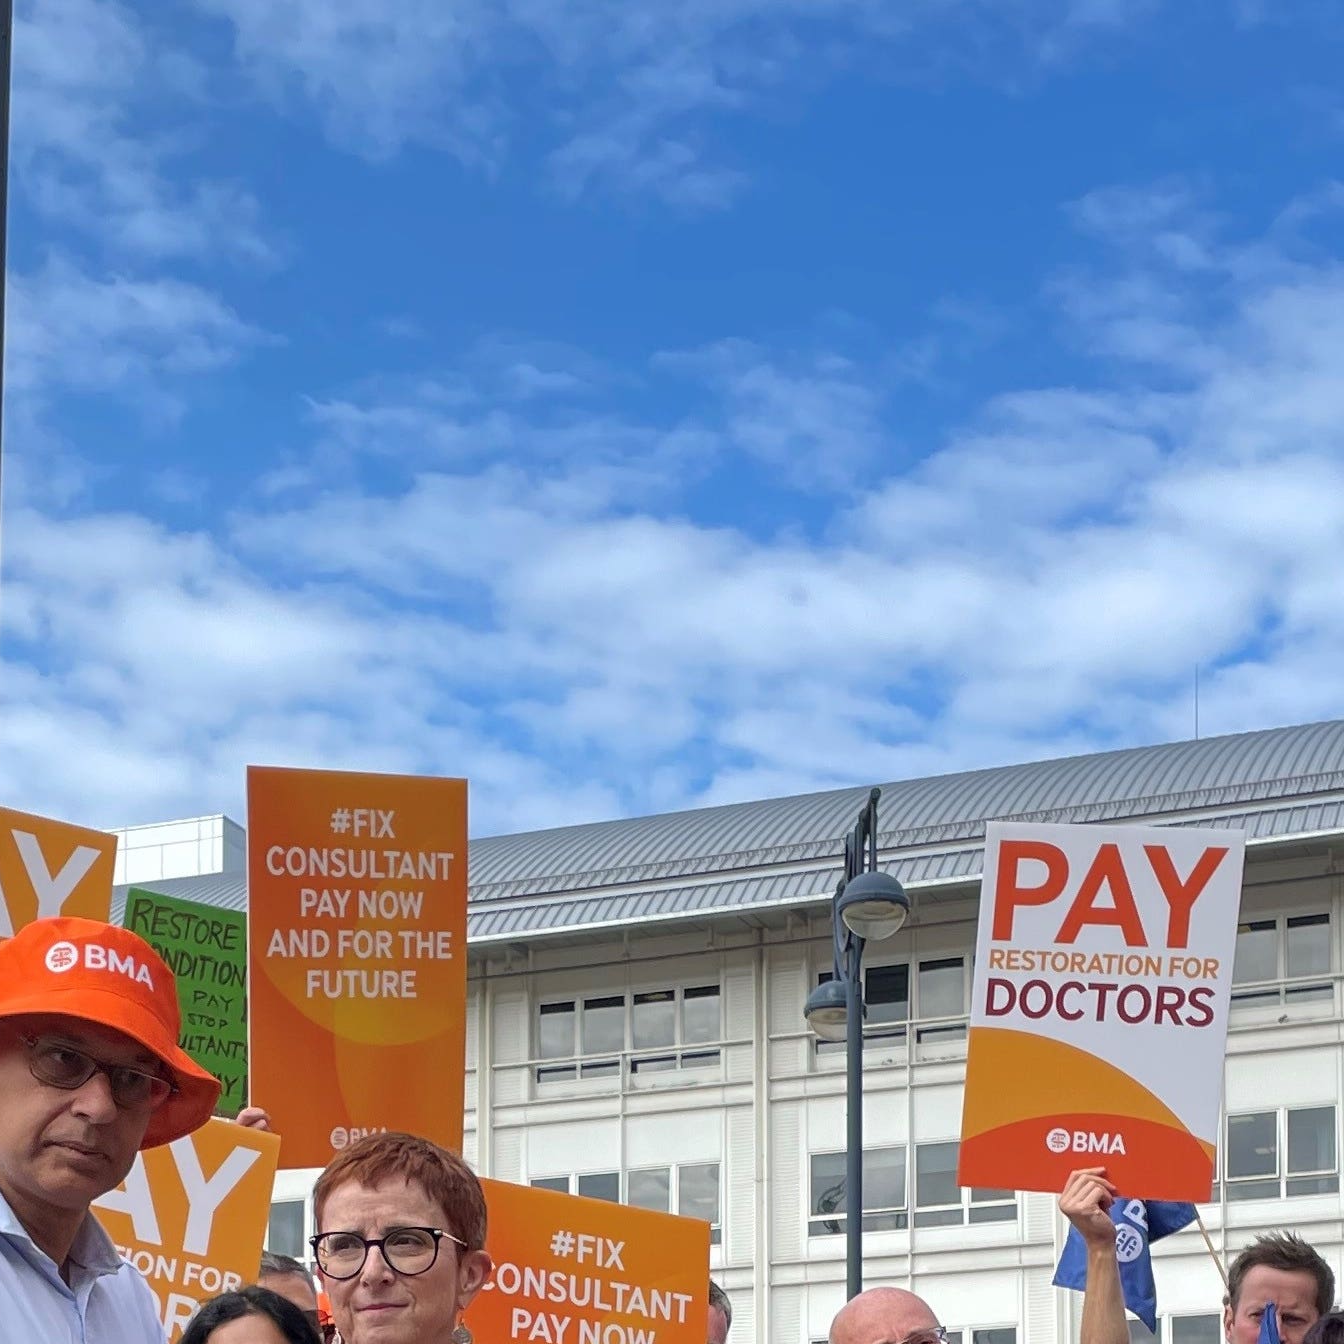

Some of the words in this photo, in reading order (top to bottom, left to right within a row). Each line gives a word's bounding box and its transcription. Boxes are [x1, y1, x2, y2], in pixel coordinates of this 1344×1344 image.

[330, 807, 396, 839] #FIX
[266, 845, 454, 881] CONSULTANT
[300, 888, 351, 919] PAY
[358, 890, 424, 920] NOW
[992, 839, 1230, 949] PAY
[130, 898, 241, 951] RESTORE
[267, 928, 330, 959] AND
[337, 930, 393, 959] FOR
[399, 931, 453, 960] THE
[84, 943, 155, 993] BMA
[989, 949, 1160, 978] RESTORATION
[1168, 957, 1220, 979] FOR
[306, 969, 417, 998] FUTURE
[193, 990, 233, 1013] PAY
[985, 977, 1216, 1028] DOCTORS
[187, 1013, 229, 1030] STOP
[1072, 1132, 1126, 1156] BMA
[90, 1135, 262, 1256] AY
[550, 1230, 625, 1271] #FIX
[183, 1261, 242, 1294] FOR
[511, 1307, 571, 1344] PAY
